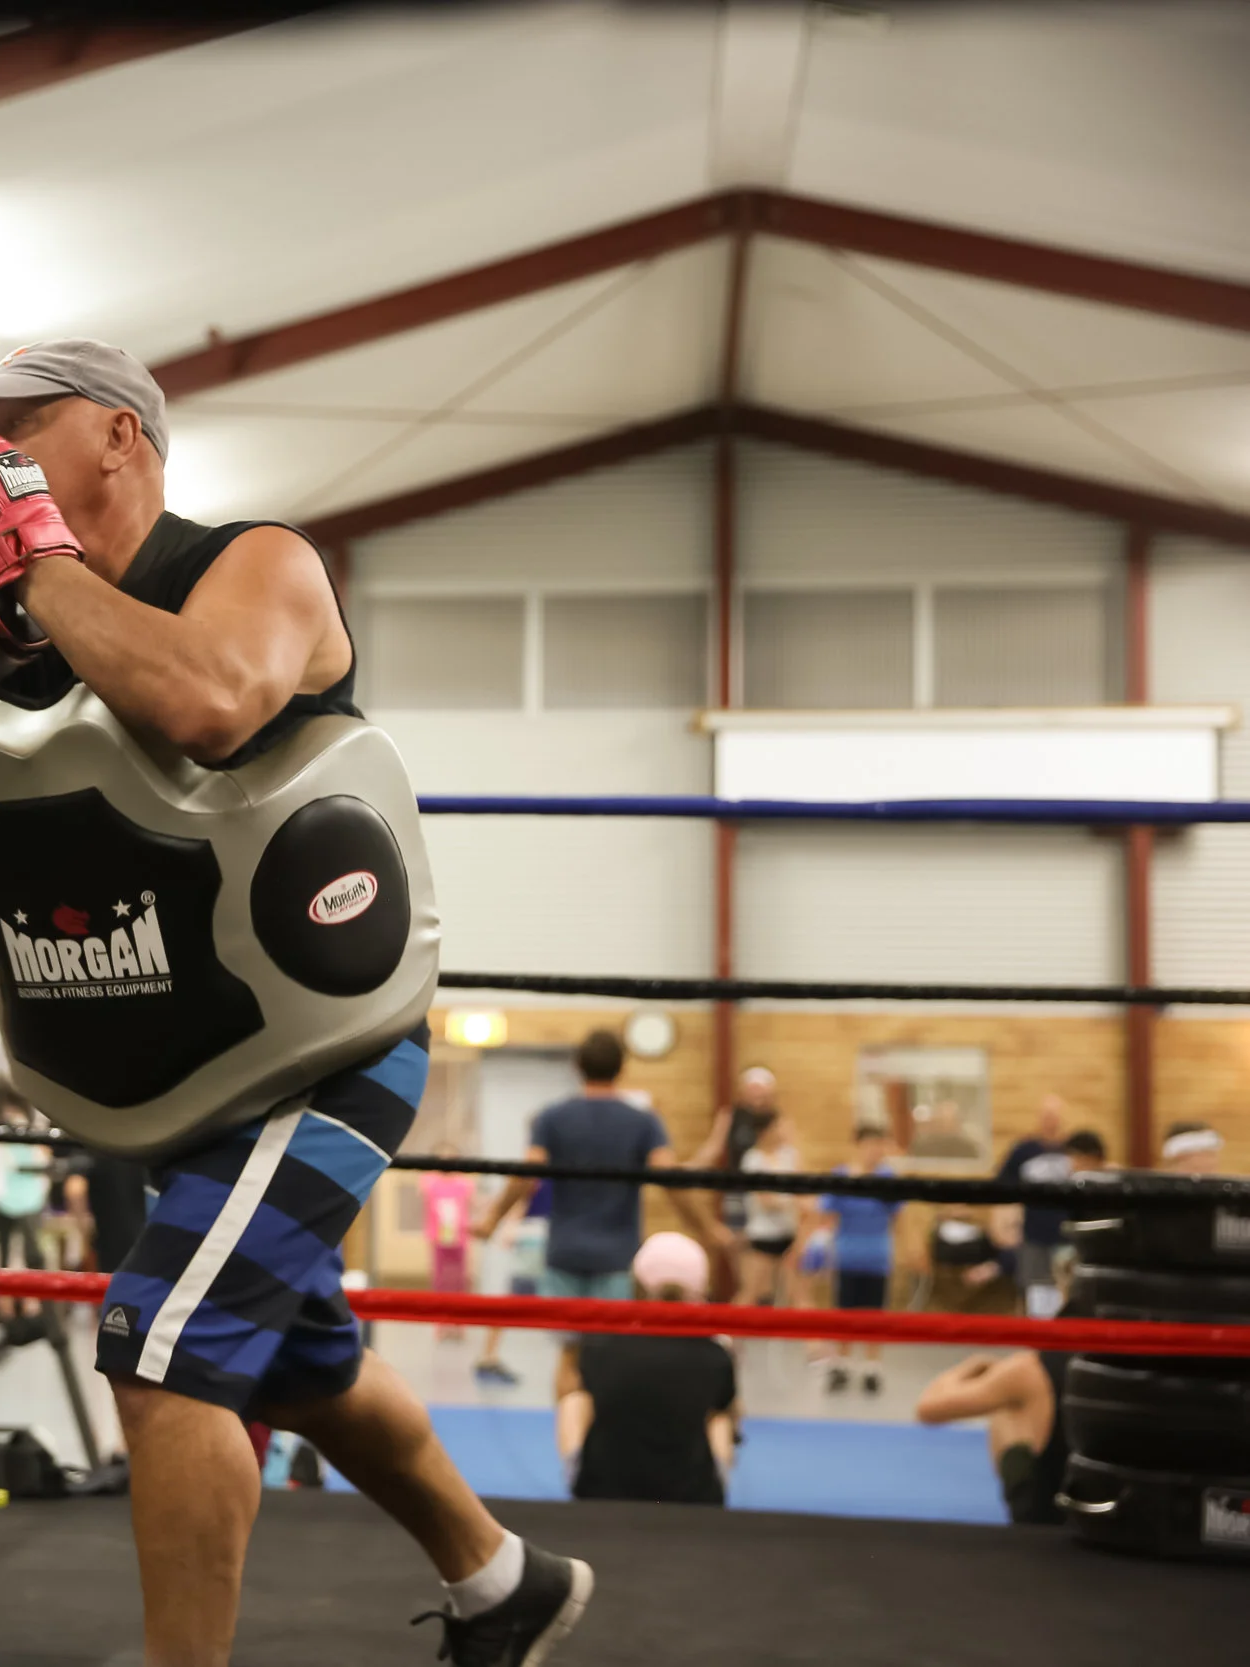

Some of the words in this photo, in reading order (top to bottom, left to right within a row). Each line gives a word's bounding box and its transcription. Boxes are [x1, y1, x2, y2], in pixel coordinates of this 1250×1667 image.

[322, 876, 367, 912] MORGAN
[0, 904, 171, 983] MORGAN
[52, 986, 61, 999] &
[62, 985, 104, 998] FITNESS
[106, 980, 173, 997] EQUIPMENT
